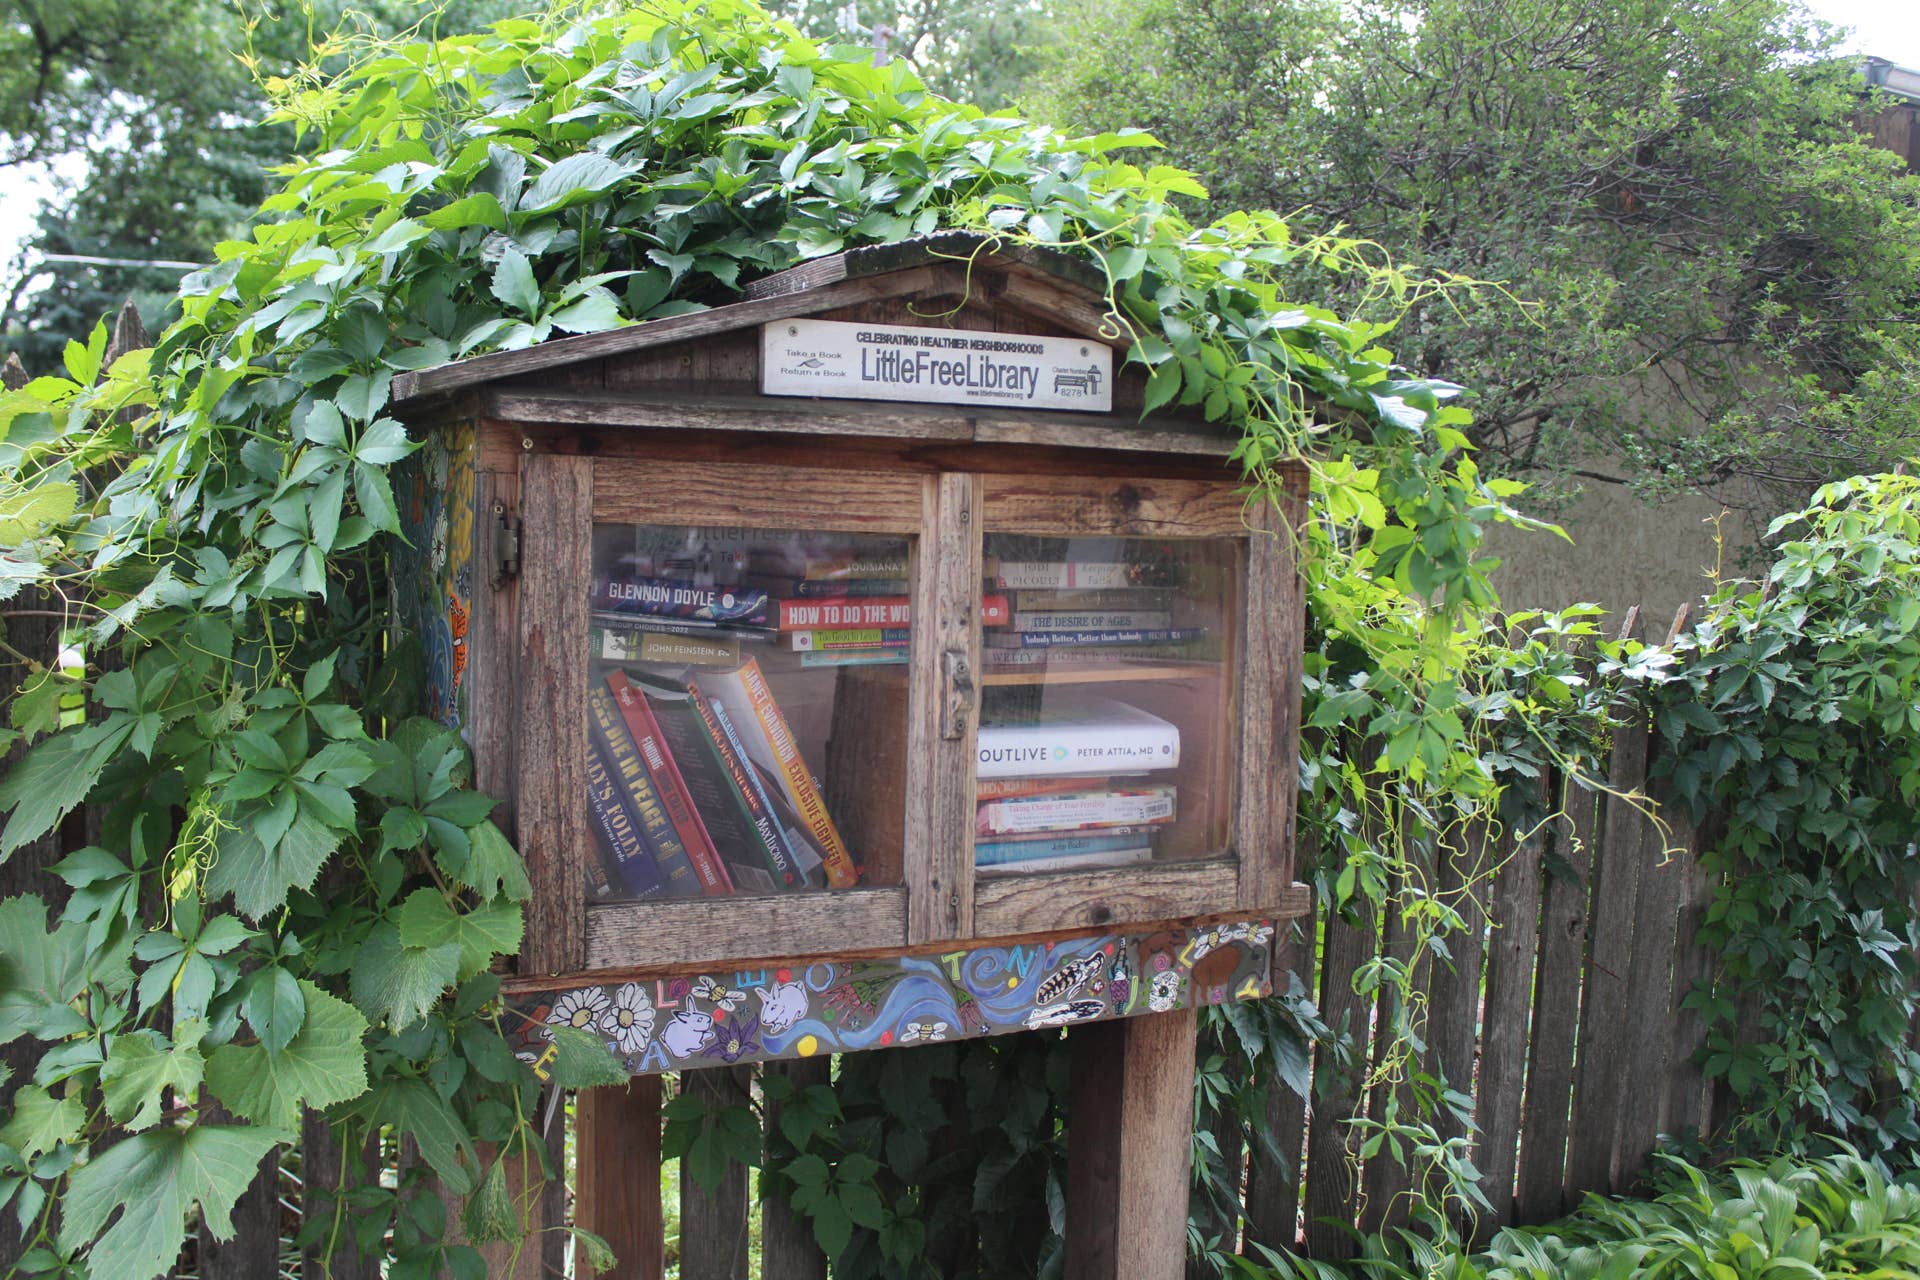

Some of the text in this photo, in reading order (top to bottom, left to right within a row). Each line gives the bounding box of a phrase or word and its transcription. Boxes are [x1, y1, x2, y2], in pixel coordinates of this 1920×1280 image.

[785, 349, 807, 357] Take
[819, 351, 842, 359] Book
[856, 332, 1044, 354] CELEBRATING HEALTHIER NEIGHBORHOODS
[780, 367, 812, 376] Return
[823, 369, 847, 377] Book
[1061, 388, 1082, 397] 8278
[608, 582, 670, 603] GLENNON
[674, 589, 716, 607] DOYLE
[789, 605, 910, 625] HOW TO DO THE WO
[1033, 616, 1132, 627] THE DESIRE OF AGES
[1101, 632, 1117, 641] than
[647, 643, 715, 656] JOHN FEINSTEIN
[605, 726, 632, 758] DIE
[642, 735, 664, 770] FINDING
[979, 747, 1047, 762] OUTLIVE
[1077, 748, 1104, 757] PETER
[1139, 746, 1153, 755] MD
[619, 755, 641, 779] IN
[745, 668, 769, 705] JANET
[760, 703, 795, 764] EVANOVICH
[788, 762, 819, 820] EXPLOSIVE
[812, 813, 842, 868] EIGHTEEN
[587, 744, 643, 859] LLY'S FOLLY
[628, 777, 666, 832] PEACE
[601, 813, 616, 841] Vincent
[612, 841, 625, 863] Lardo
[755, 816, 772, 840] MAX
[764, 834, 787, 871] LUCADO
